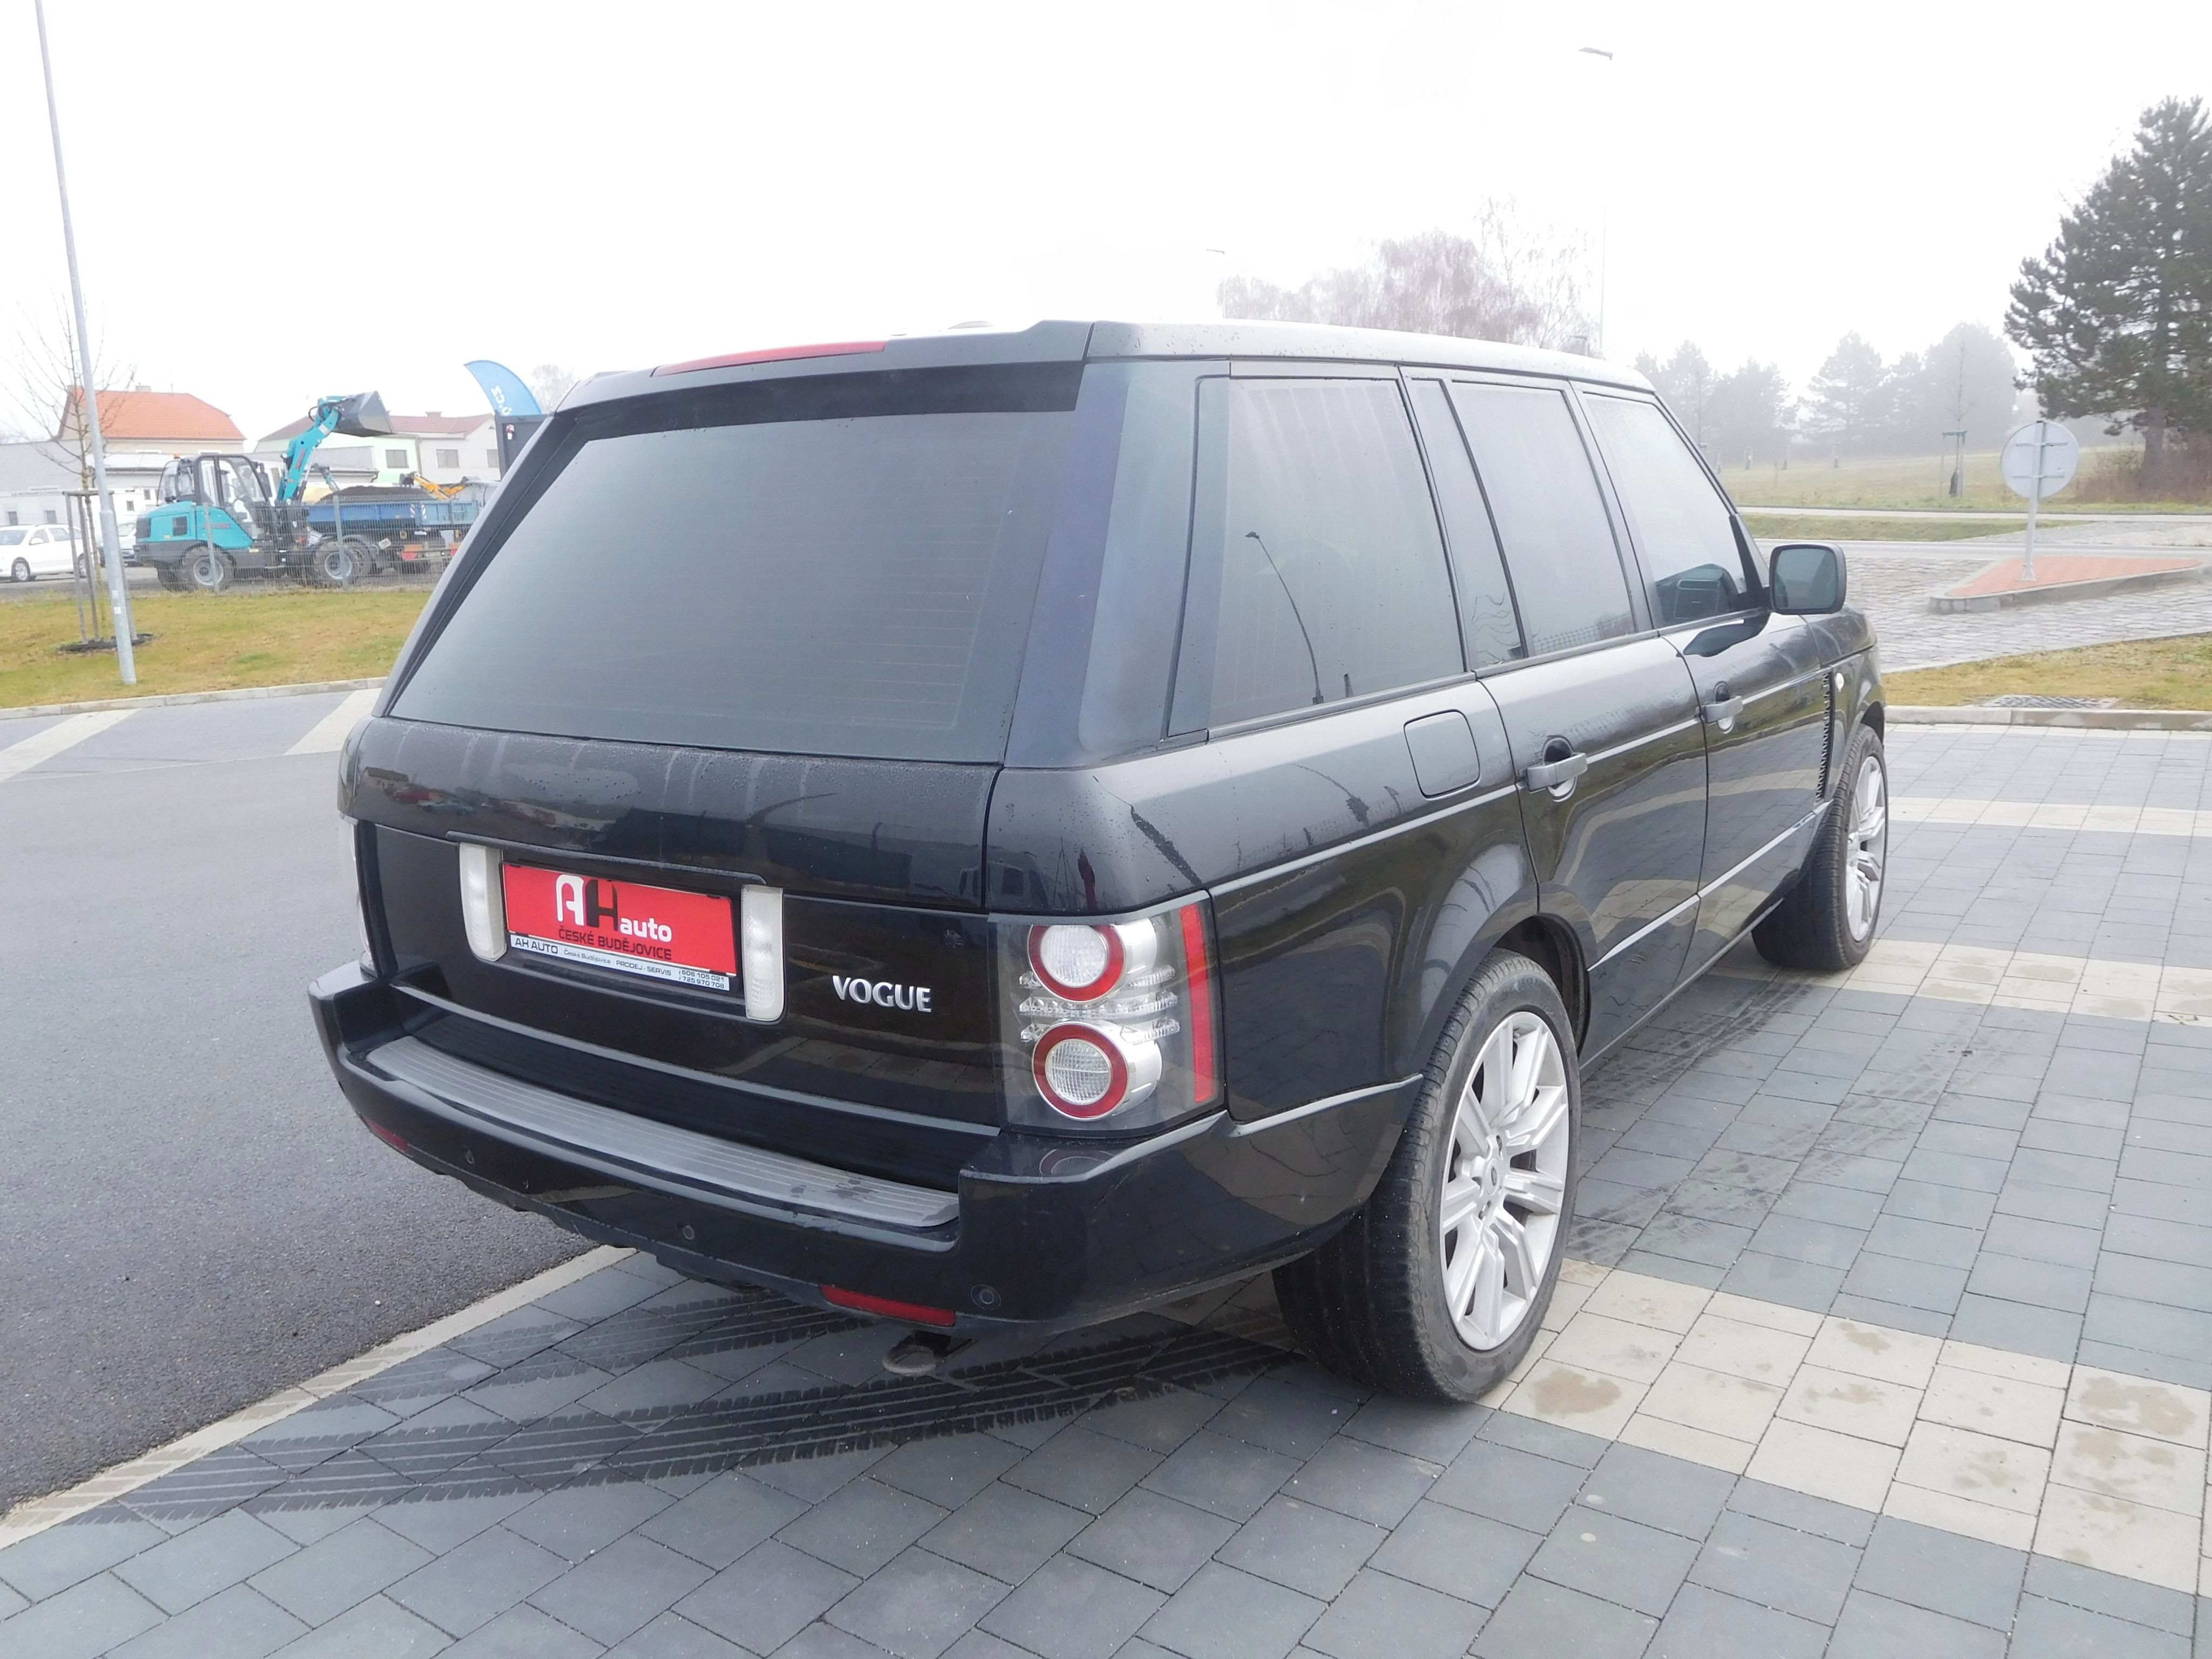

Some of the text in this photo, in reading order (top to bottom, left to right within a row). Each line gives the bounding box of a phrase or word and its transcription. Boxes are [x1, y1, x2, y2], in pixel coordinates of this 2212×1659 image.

[515, 938, 529, 947] AH
[531, 941, 558, 954] AUTO
[616, 960, 643, 970] PRODEJ
[647, 966, 672, 976] SERVIS
[558, 925, 672, 960] ČESKÉ BUDĚJOVICE
[832, 975, 932, 1013] VOGUE
